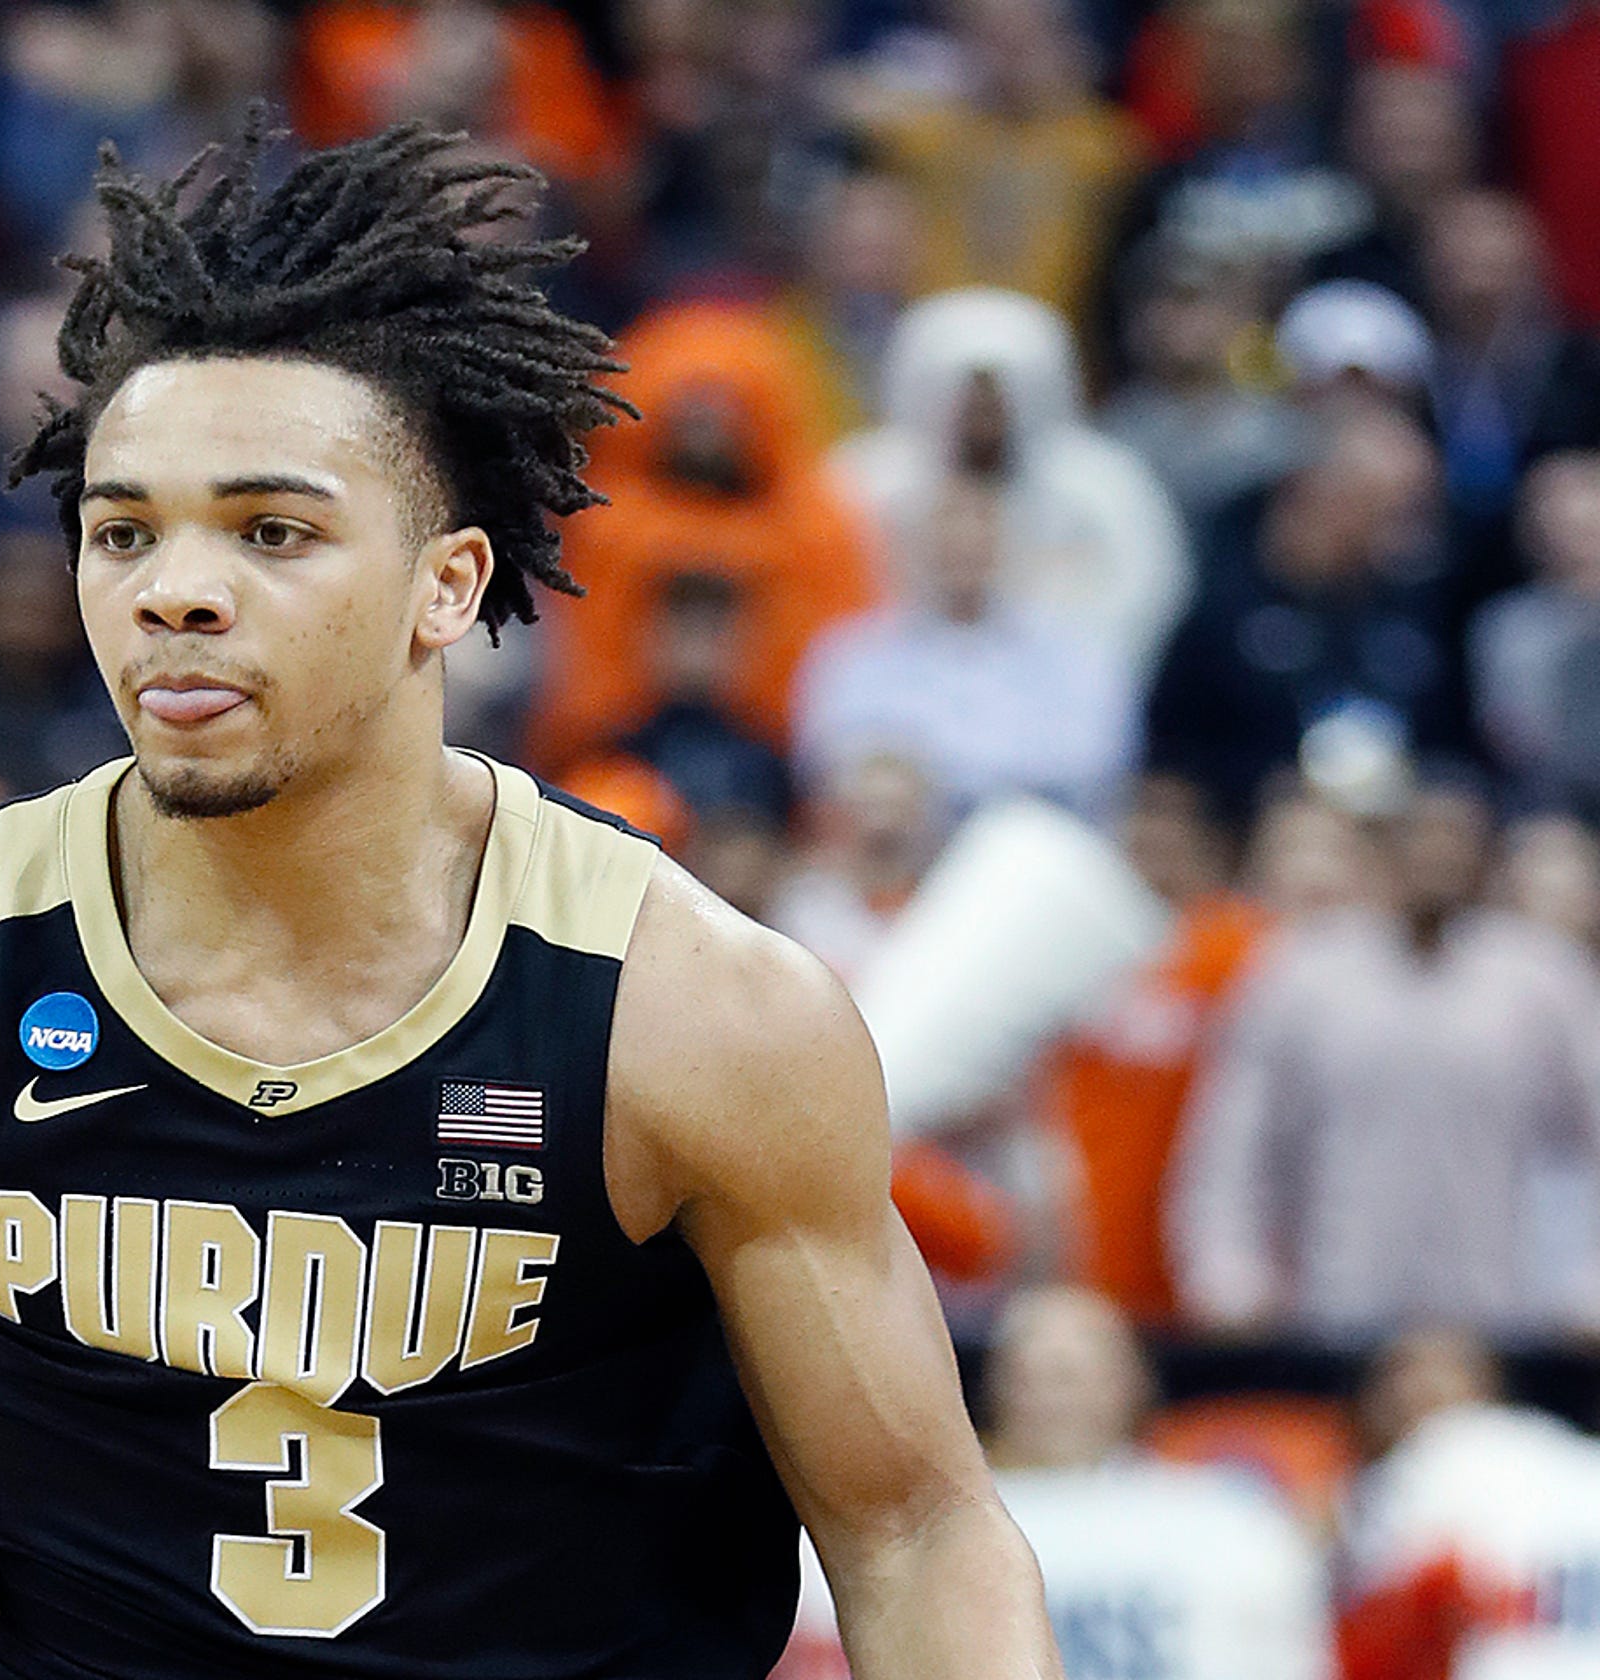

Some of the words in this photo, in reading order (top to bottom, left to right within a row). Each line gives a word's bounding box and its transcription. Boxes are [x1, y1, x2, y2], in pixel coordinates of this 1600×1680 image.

[27, 1025, 92, 1053] NCAA
[249, 1080, 298, 1107] P
[209, 1378, 385, 1638] 3
